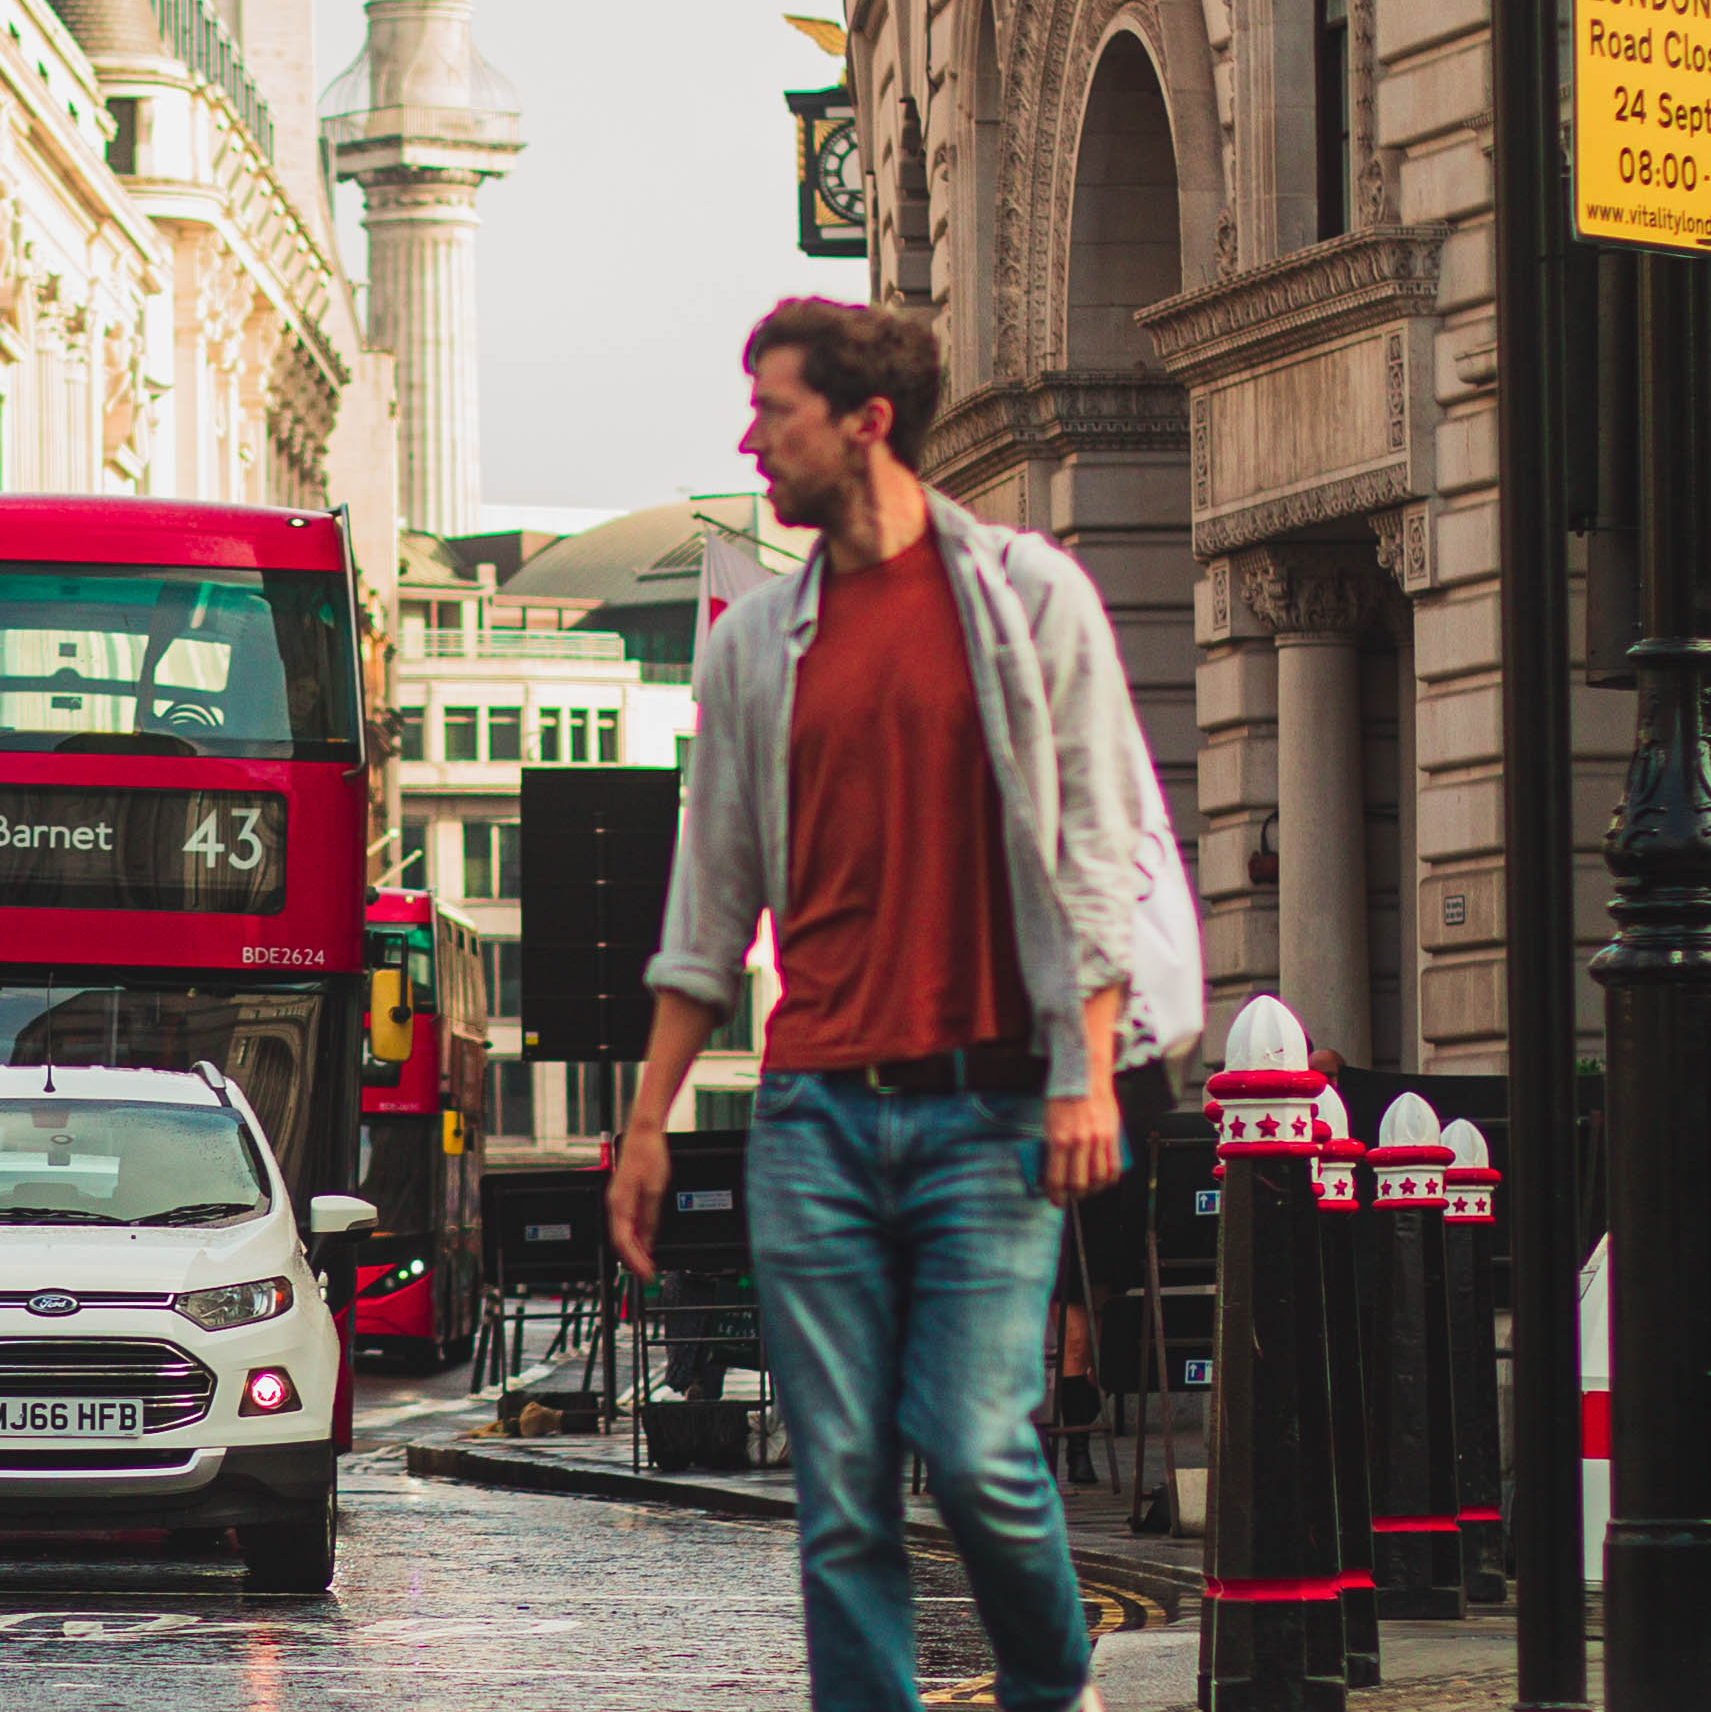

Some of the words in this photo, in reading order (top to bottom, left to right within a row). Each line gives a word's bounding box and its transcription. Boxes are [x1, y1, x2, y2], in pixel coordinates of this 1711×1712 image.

[1590, 18, 1652, 64] Road
[1614, 85, 1647, 124] 24
[1619, 147, 1697, 191] 08:00
[182, 807, 263, 869] 43
[242, 946, 326, 966] BDE2624
[38, 1295, 67, 1309] Ford
[77, 1402, 137, 1431] HFB
